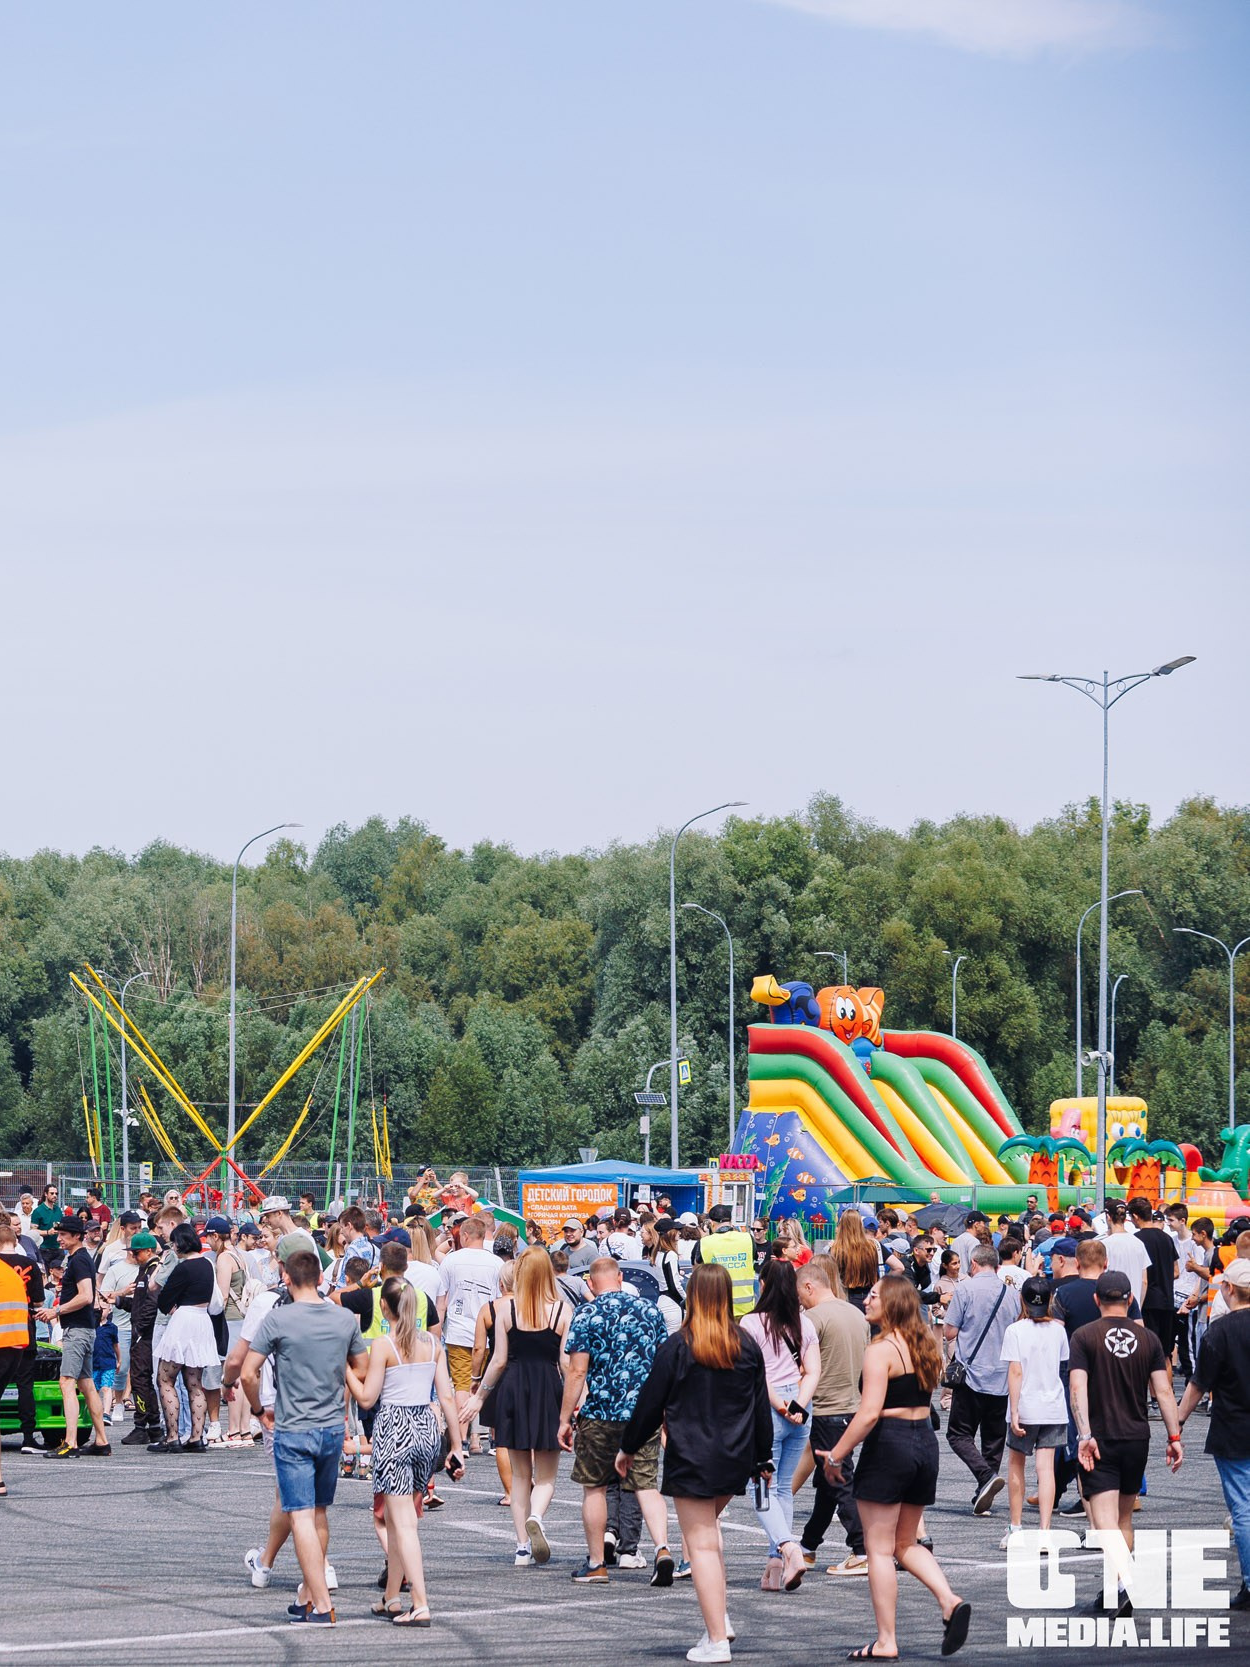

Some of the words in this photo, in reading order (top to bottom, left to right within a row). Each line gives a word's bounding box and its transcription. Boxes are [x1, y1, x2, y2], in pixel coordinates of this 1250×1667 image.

[719, 1153, 759, 1169] КАССА
[527, 1186, 569, 1203] ДЕТСКИЙ
[571, 1188, 613, 1203] ГОРОДОК
